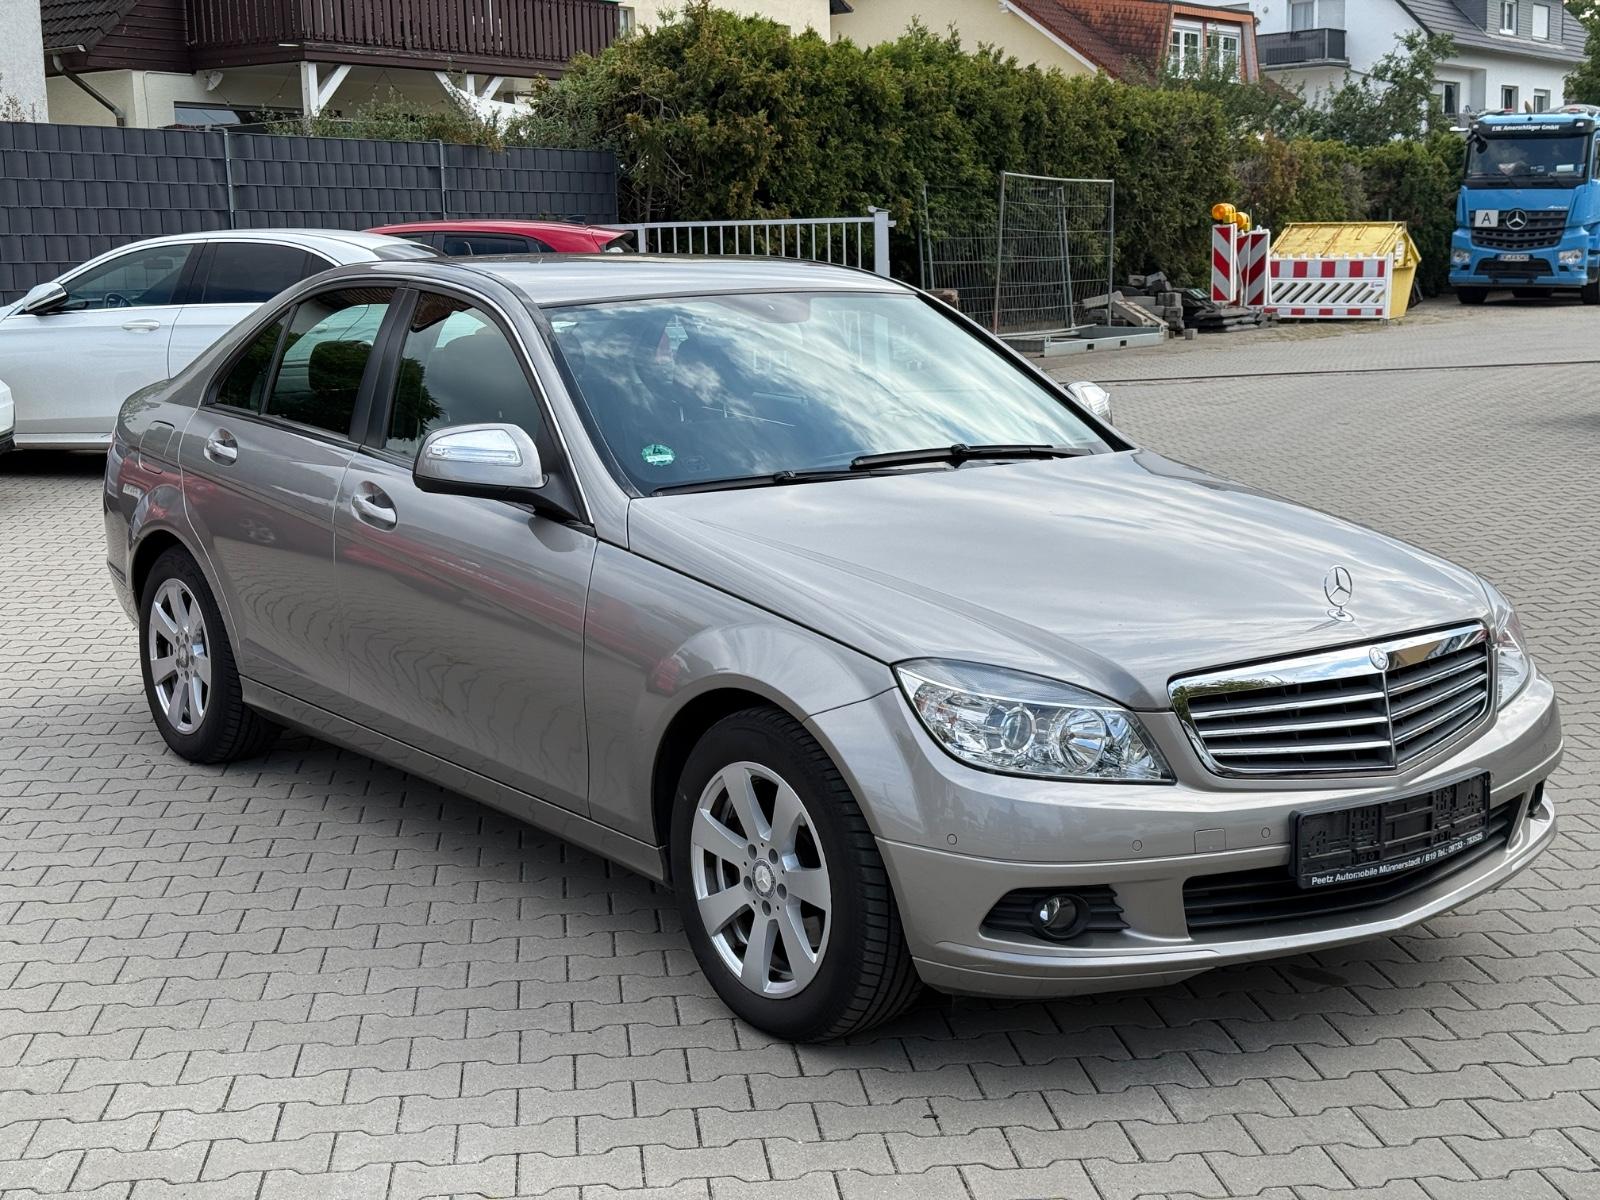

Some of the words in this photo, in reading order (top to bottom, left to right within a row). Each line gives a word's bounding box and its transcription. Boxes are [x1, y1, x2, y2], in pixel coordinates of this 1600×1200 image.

[1481, 212, 1492, 225] A
[653, 445, 663, 455] 4
[1311, 875, 1334, 886] Peetz
[1335, 867, 1378, 882] Automobile
[1379, 856, 1421, 874] Münnerstadt
[1425, 851, 1437, 862] B19
